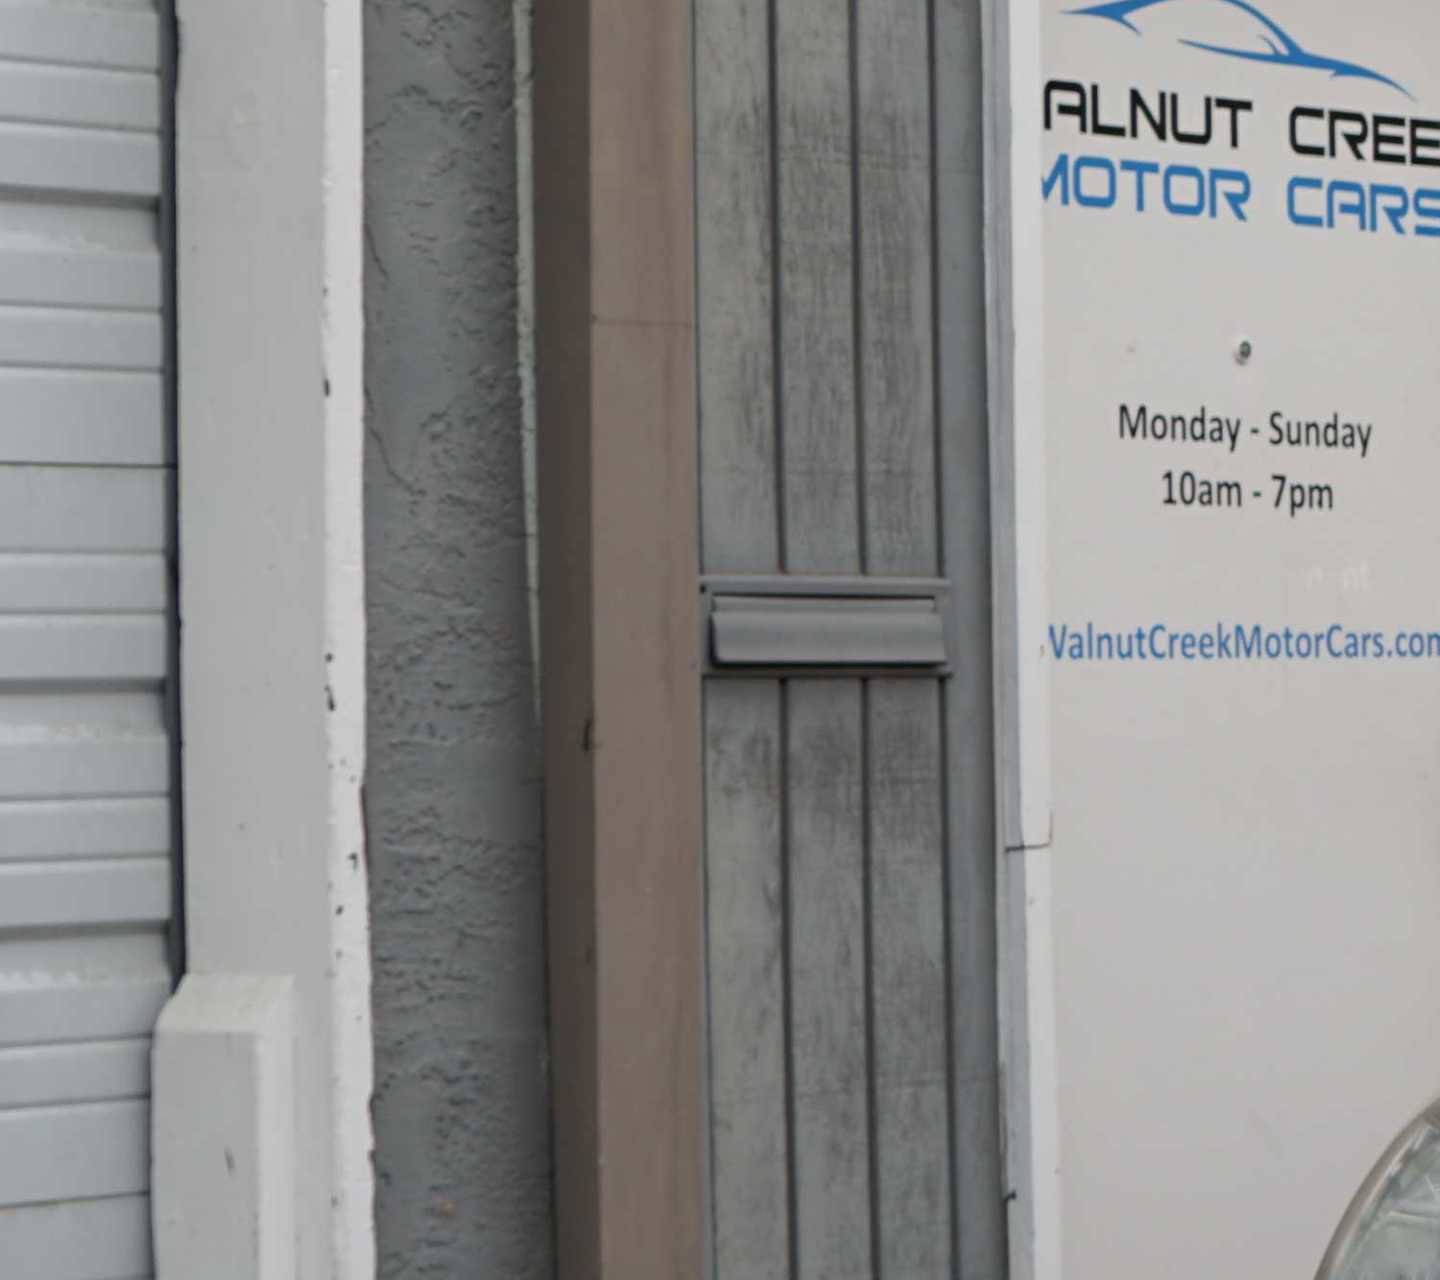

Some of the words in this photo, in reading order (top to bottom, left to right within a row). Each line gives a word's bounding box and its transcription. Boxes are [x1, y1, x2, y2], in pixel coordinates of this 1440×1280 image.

[1043, 79, 1253, 149] ALNUT
[1118, 404, 1242, 452] Monday
[1268, 411, 1373, 457] Sunday
[1161, 470, 1243, 508] 10am
[1271, 475, 1335, 517] 7pm
